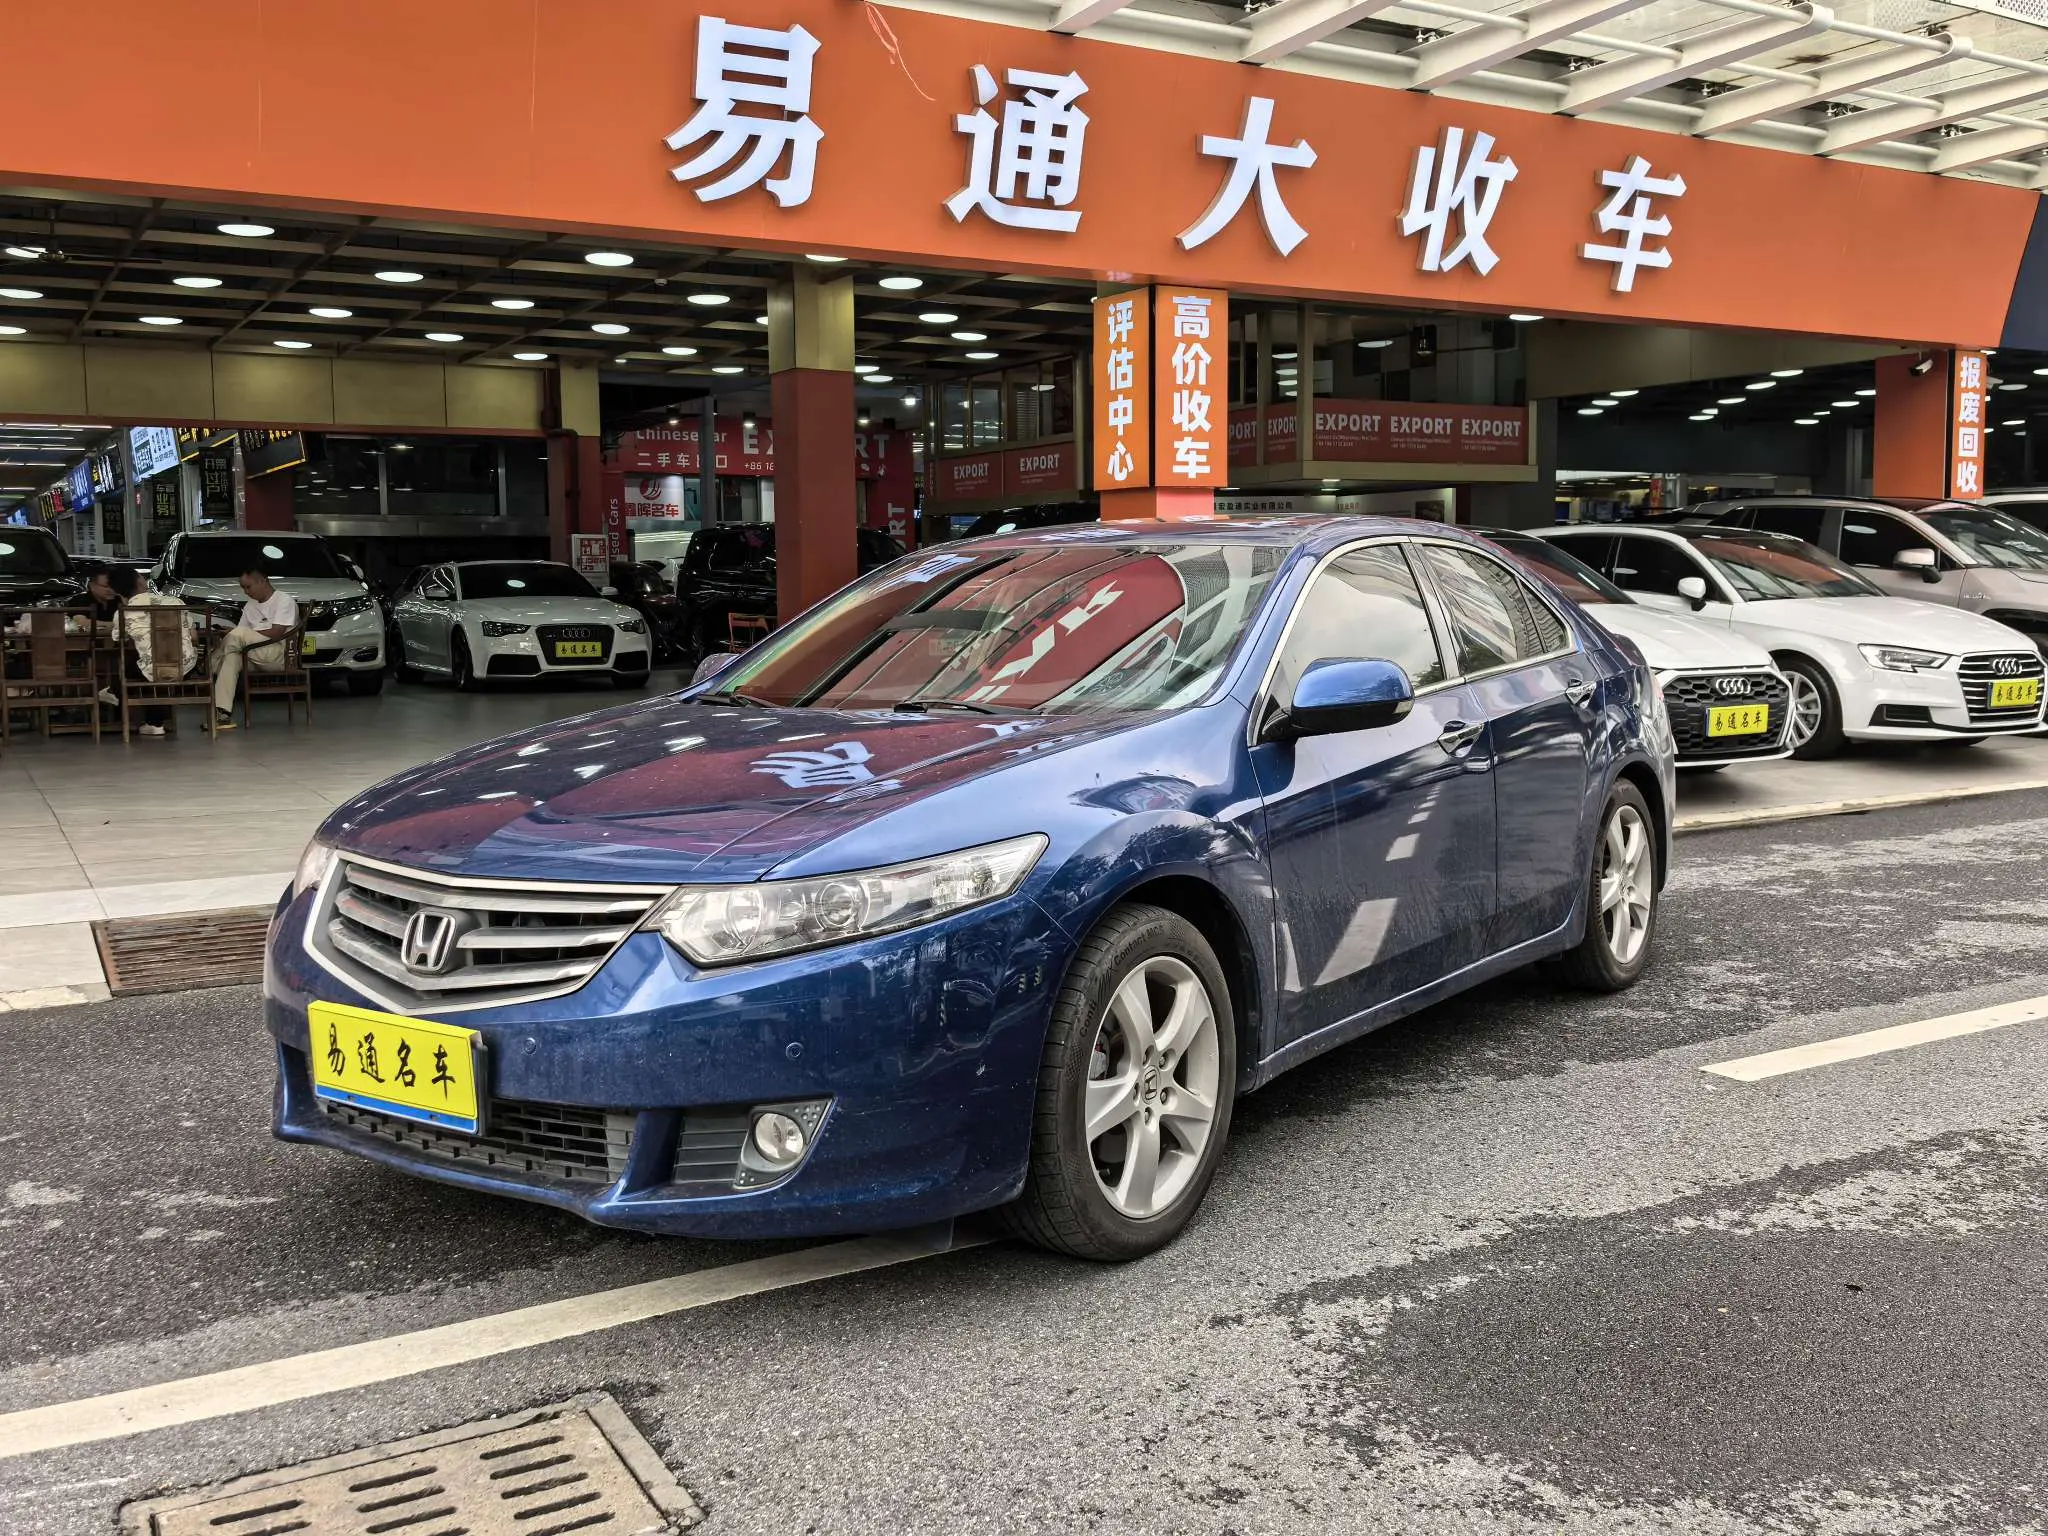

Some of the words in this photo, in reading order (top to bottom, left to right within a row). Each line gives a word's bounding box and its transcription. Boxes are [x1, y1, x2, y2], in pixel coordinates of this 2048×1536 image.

[664, 15, 1688, 292] 易通大收车
[1107, 300, 1134, 481] 评估中心
[1172, 296, 1212, 479] 高价收车
[1315, 413, 1382, 433] EXPORT
[1390, 415, 1453, 435] EXPORT
[1461, 418, 1521, 437] EXPORT
[1956, 356, 1982, 493] 报废回收
[637, 452, 728, 469] 二手车口
[1020, 453, 1060, 472] EXPORT
[954, 463, 990, 480] EXPORT
[1715, 711, 1762, 732] 易通名车
[327, 1022, 456, 1100] 易通名车
